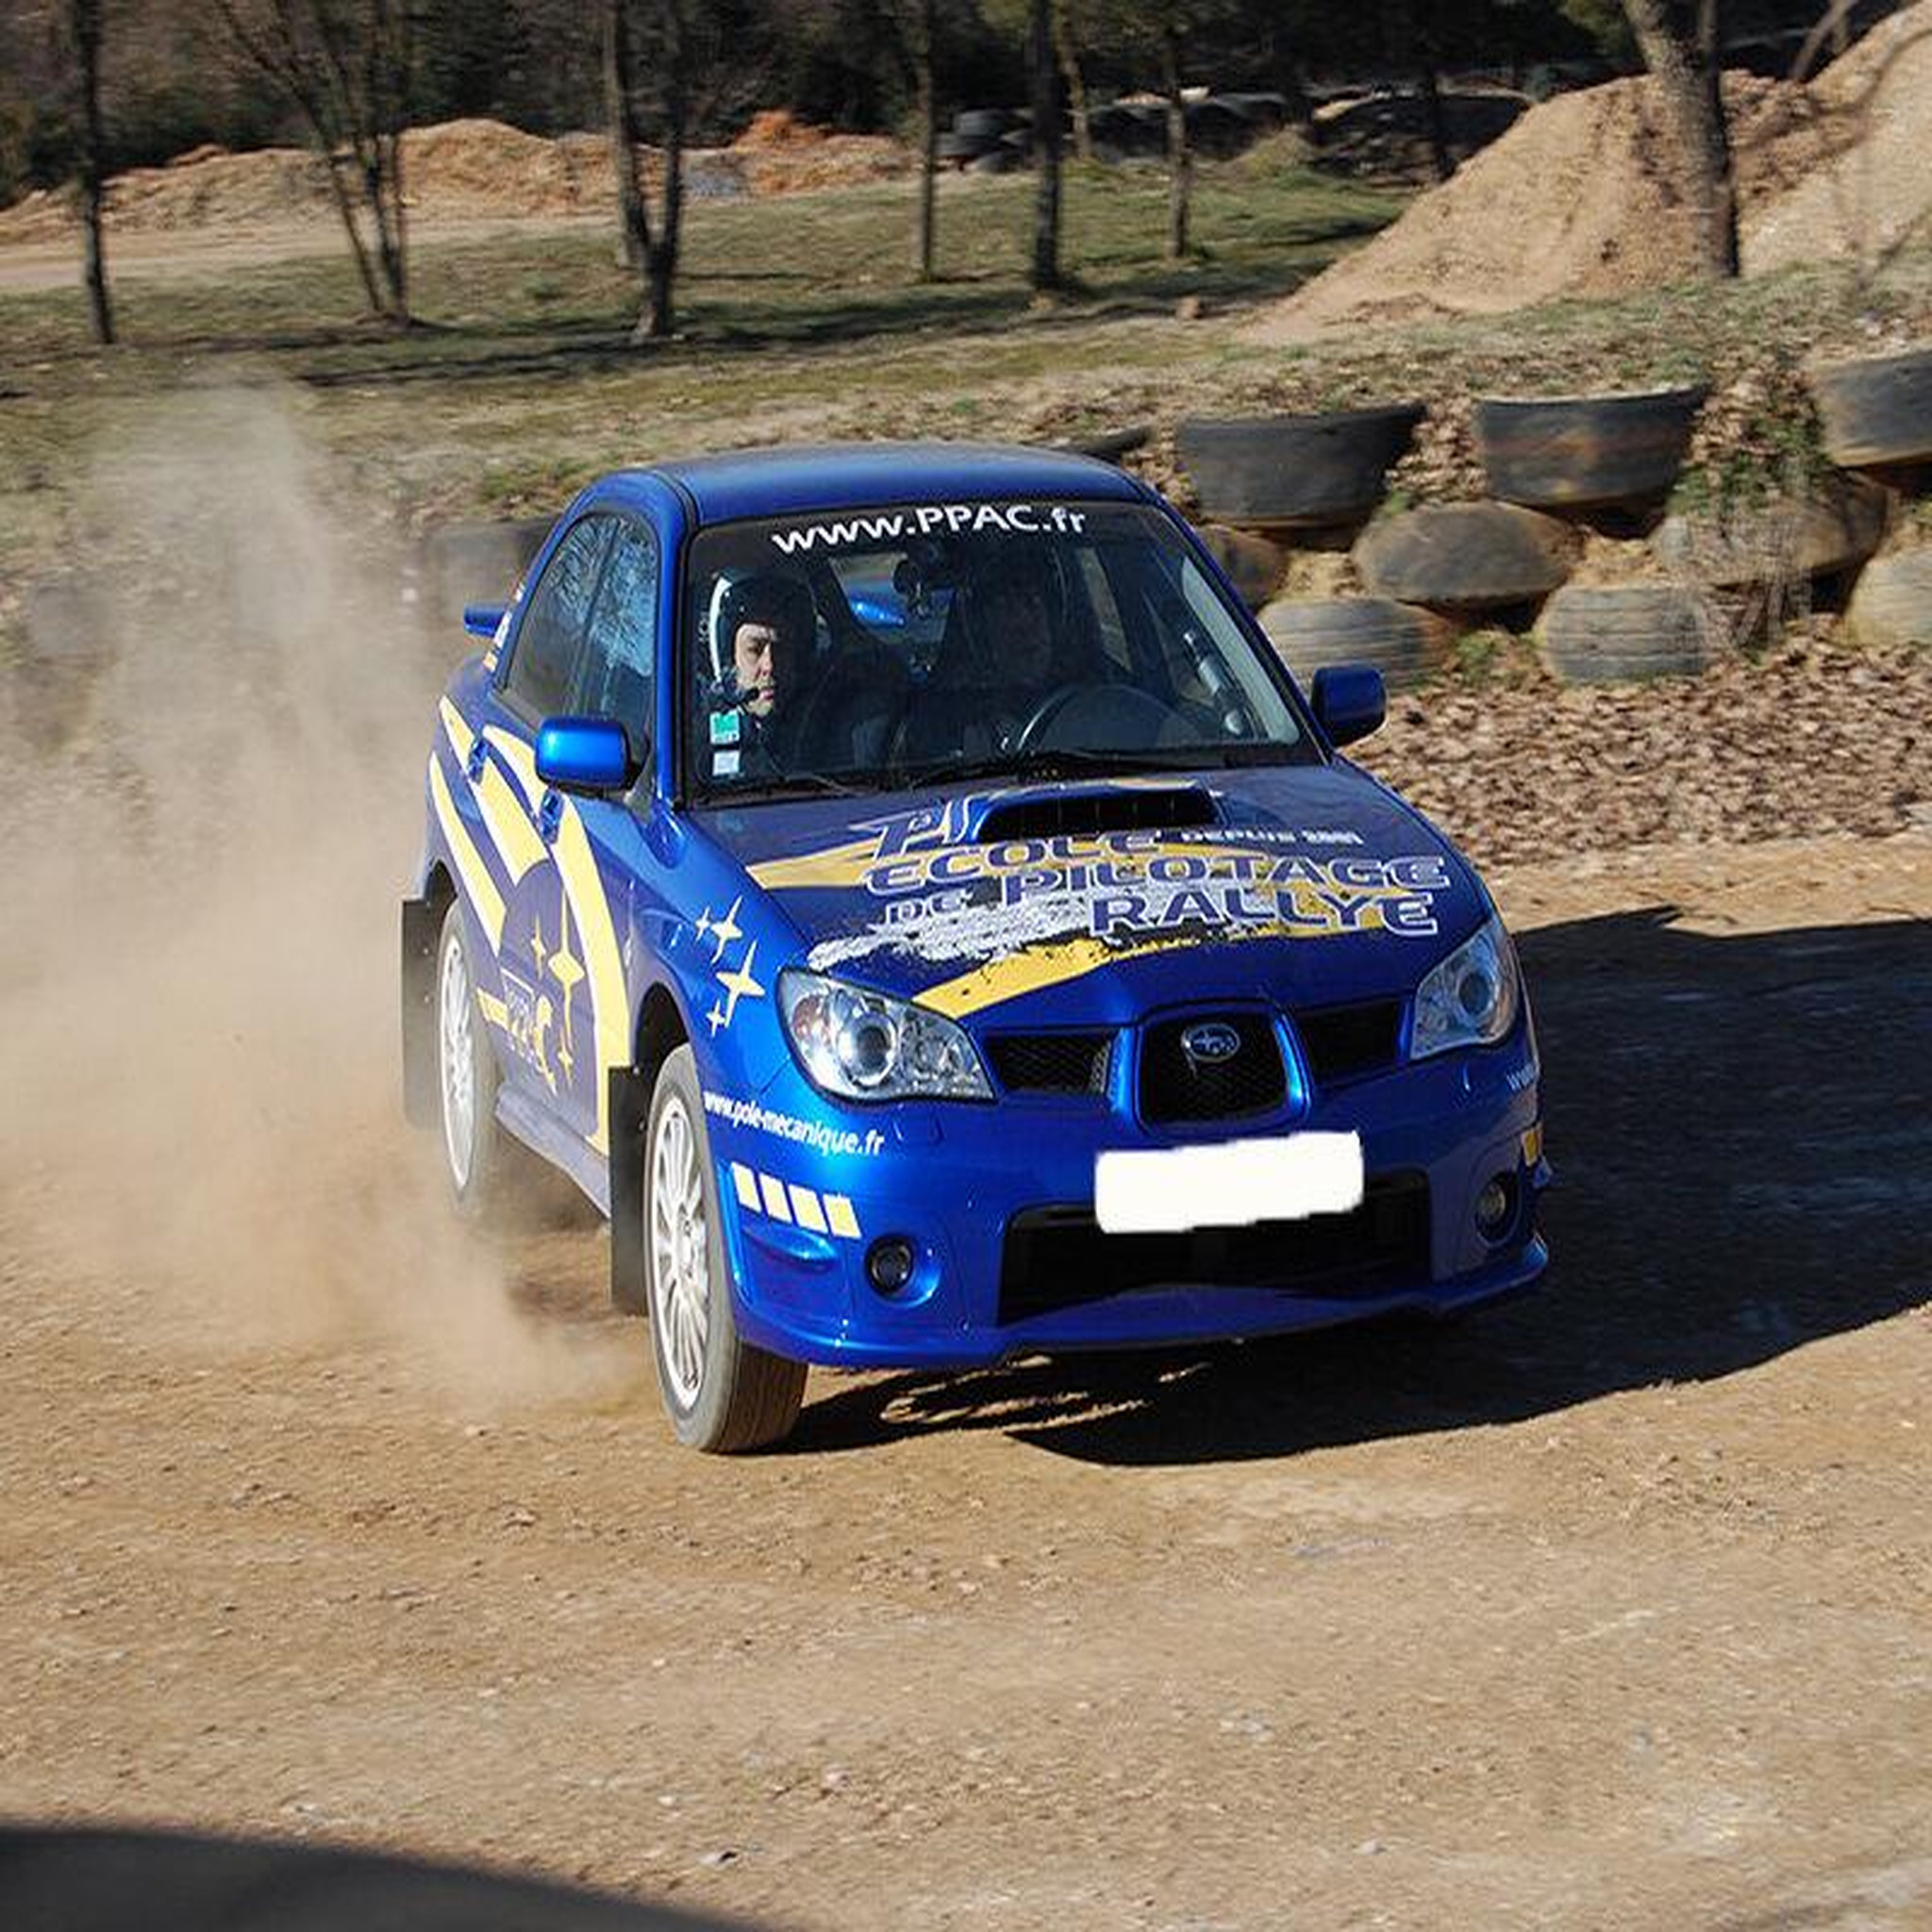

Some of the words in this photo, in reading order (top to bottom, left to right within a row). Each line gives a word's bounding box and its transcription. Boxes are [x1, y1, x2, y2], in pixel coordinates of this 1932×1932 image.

[772, 505, 1086, 555] www.PPAC.fr
[865, 830, 1162, 895] ECOLE
[1004, 856, 1451, 907] PILOTAGE
[1089, 889, 1439, 937] RALLYE
[702, 1091, 885, 1157] www.pole-mecanique.fr
